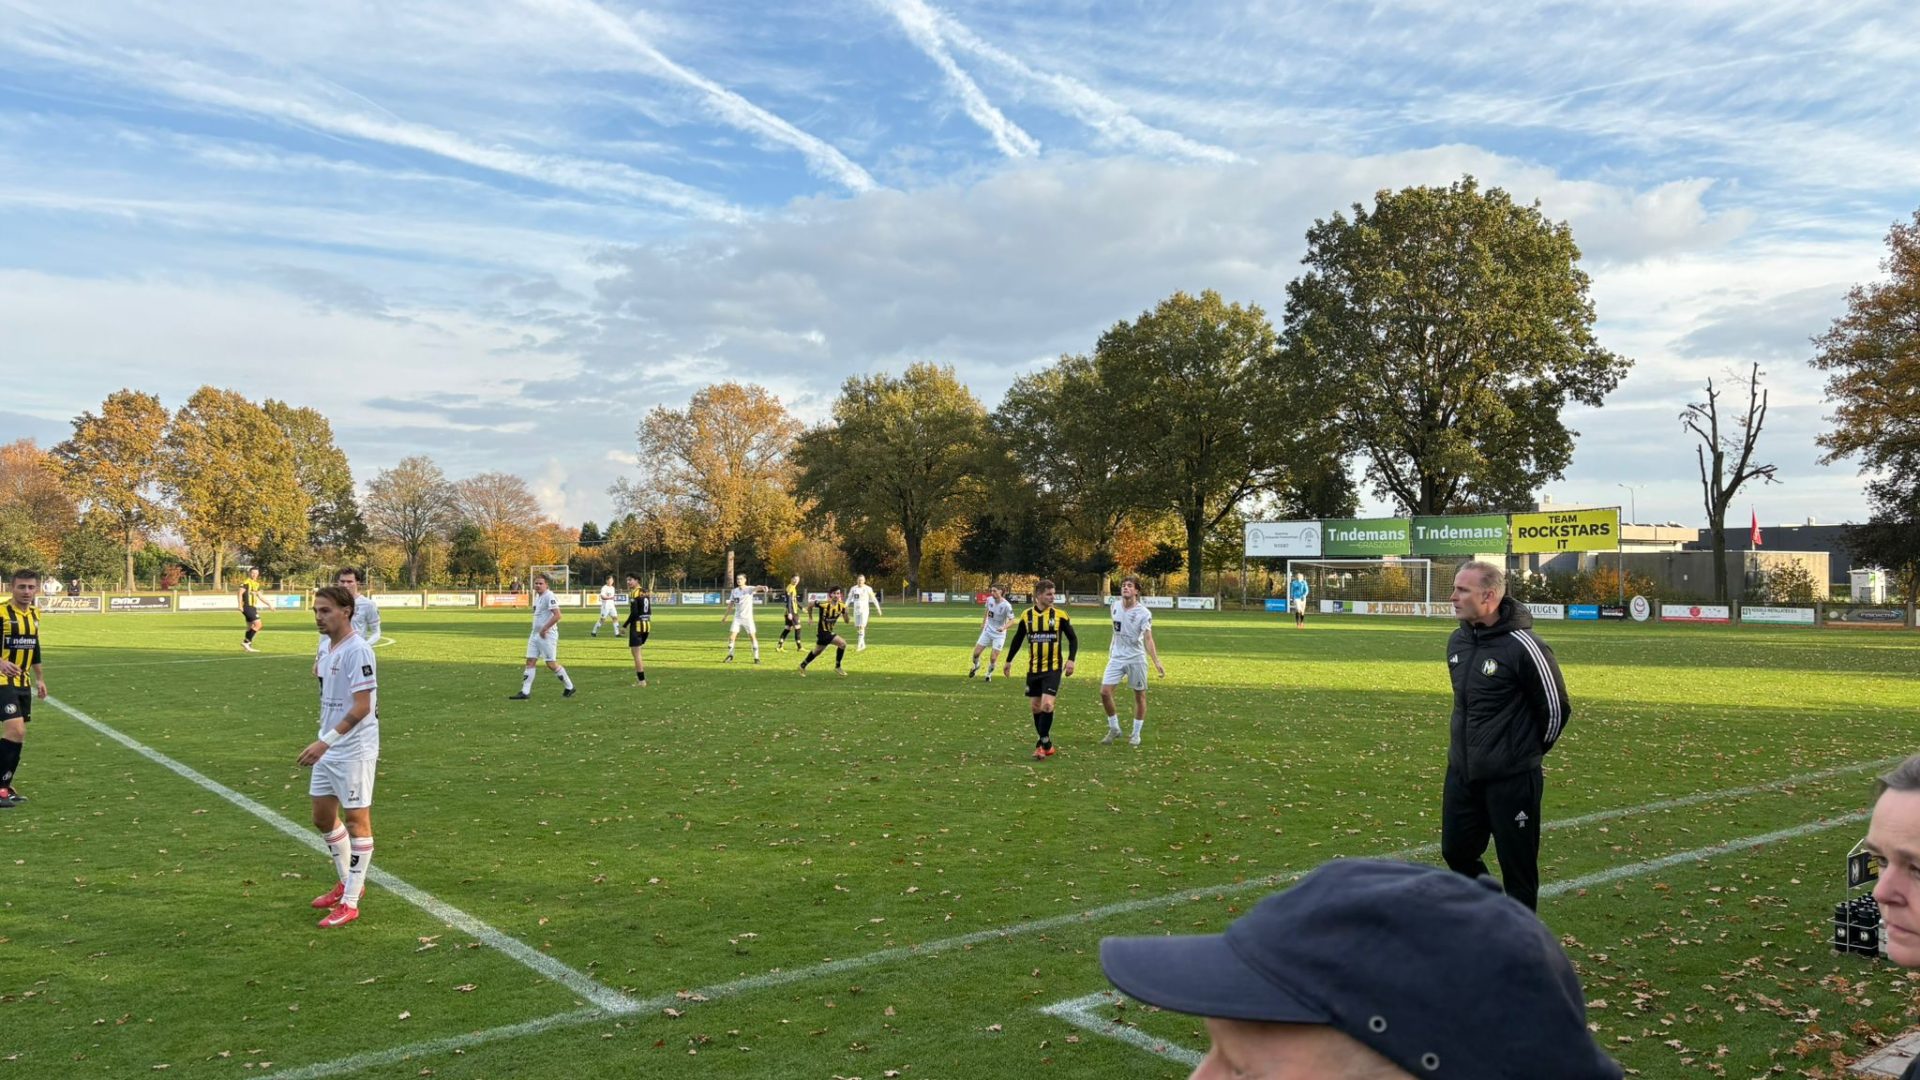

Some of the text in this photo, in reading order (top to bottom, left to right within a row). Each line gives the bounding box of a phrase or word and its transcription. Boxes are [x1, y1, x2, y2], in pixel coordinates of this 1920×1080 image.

[1548, 515, 1577, 523] TEAM
[1328, 527, 1406, 541] Tindemans
[1416, 525, 1503, 540] Tindemans
[1518, 523, 1610, 538] ROCKSTARS
[1557, 540, 1568, 549] IT
[644, 597, 649, 613] 8
